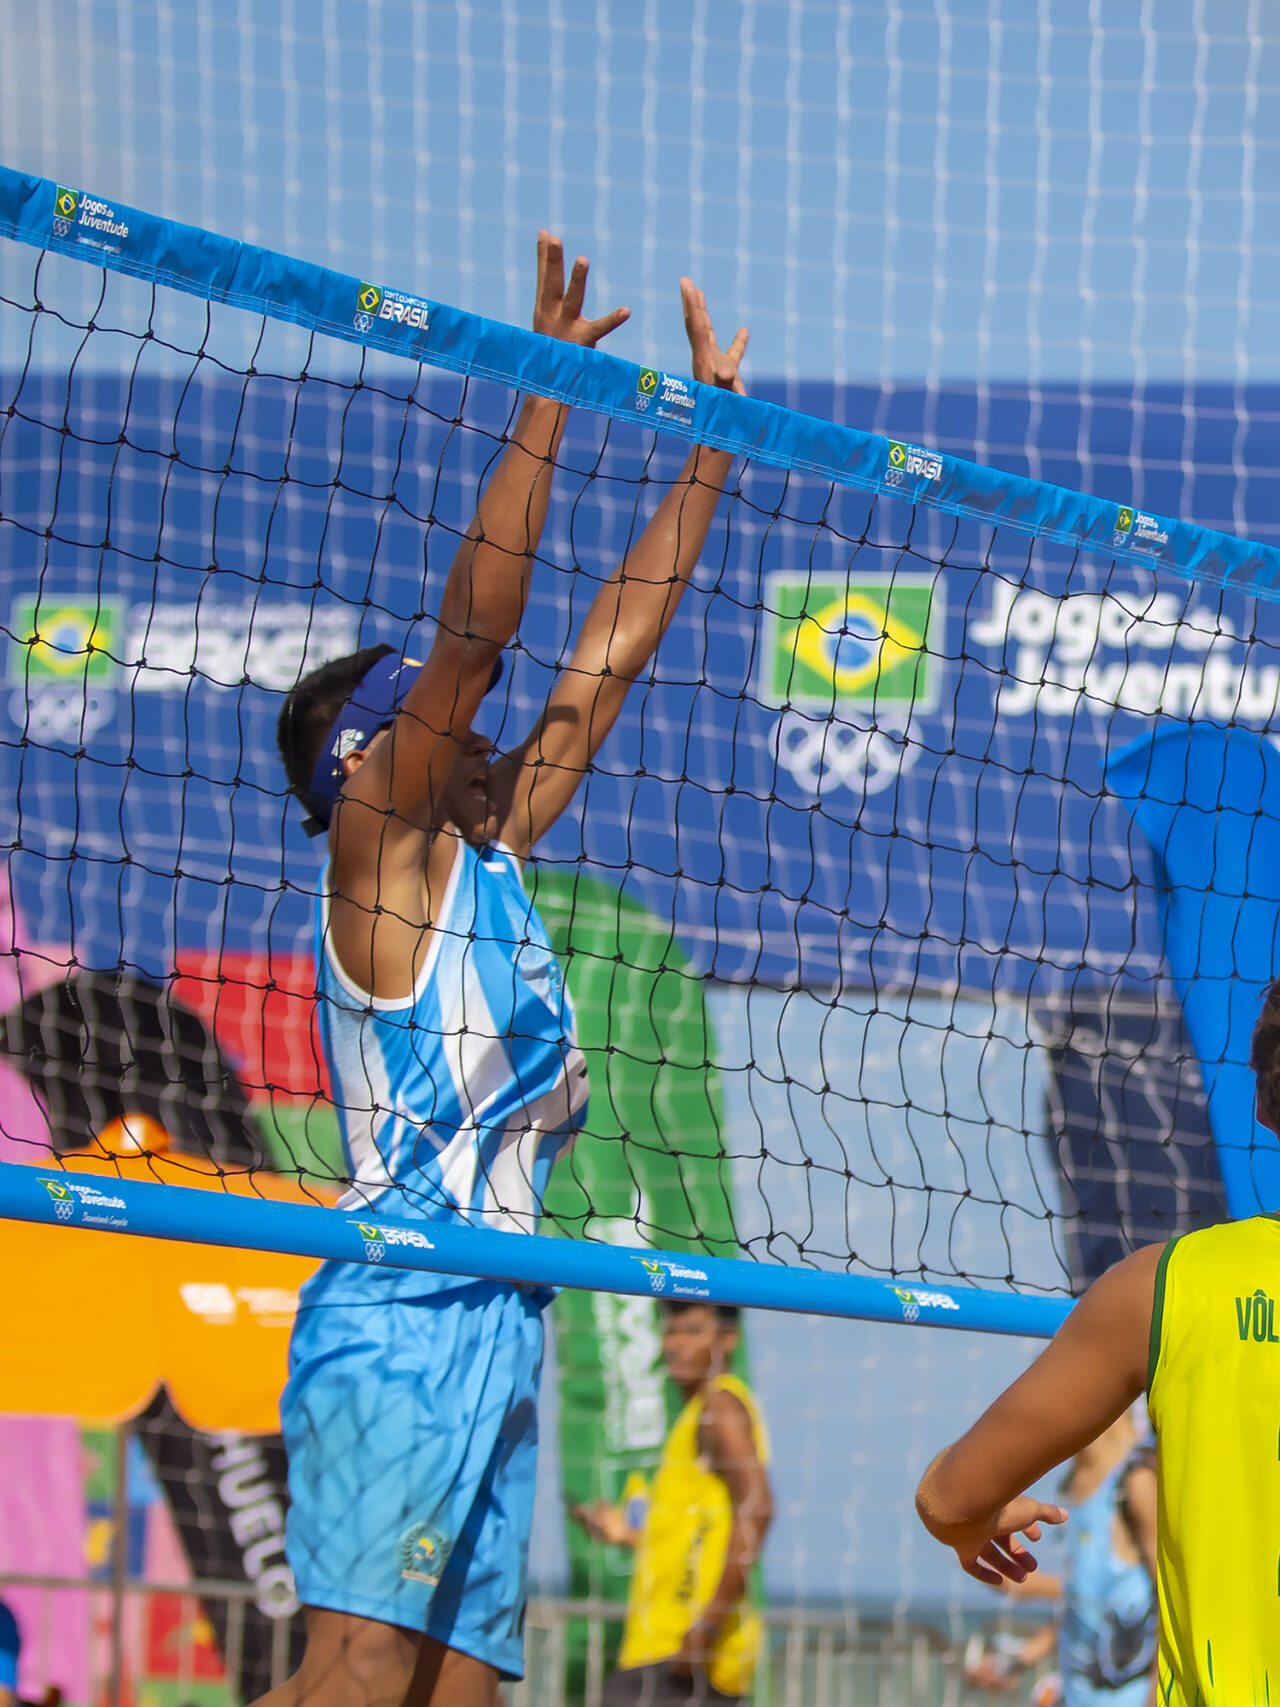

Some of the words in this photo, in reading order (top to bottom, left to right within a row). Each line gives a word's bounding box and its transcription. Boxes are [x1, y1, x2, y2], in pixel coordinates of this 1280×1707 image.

[79, 194, 108, 216] Jogos
[79, 211, 129, 238] Juventude
[379, 299, 430, 330] BRASIL
[661, 373, 683, 391] Jogos
[970, 573, 1181, 663] Jogos
[379, 1228, 435, 1250] BRASIL
